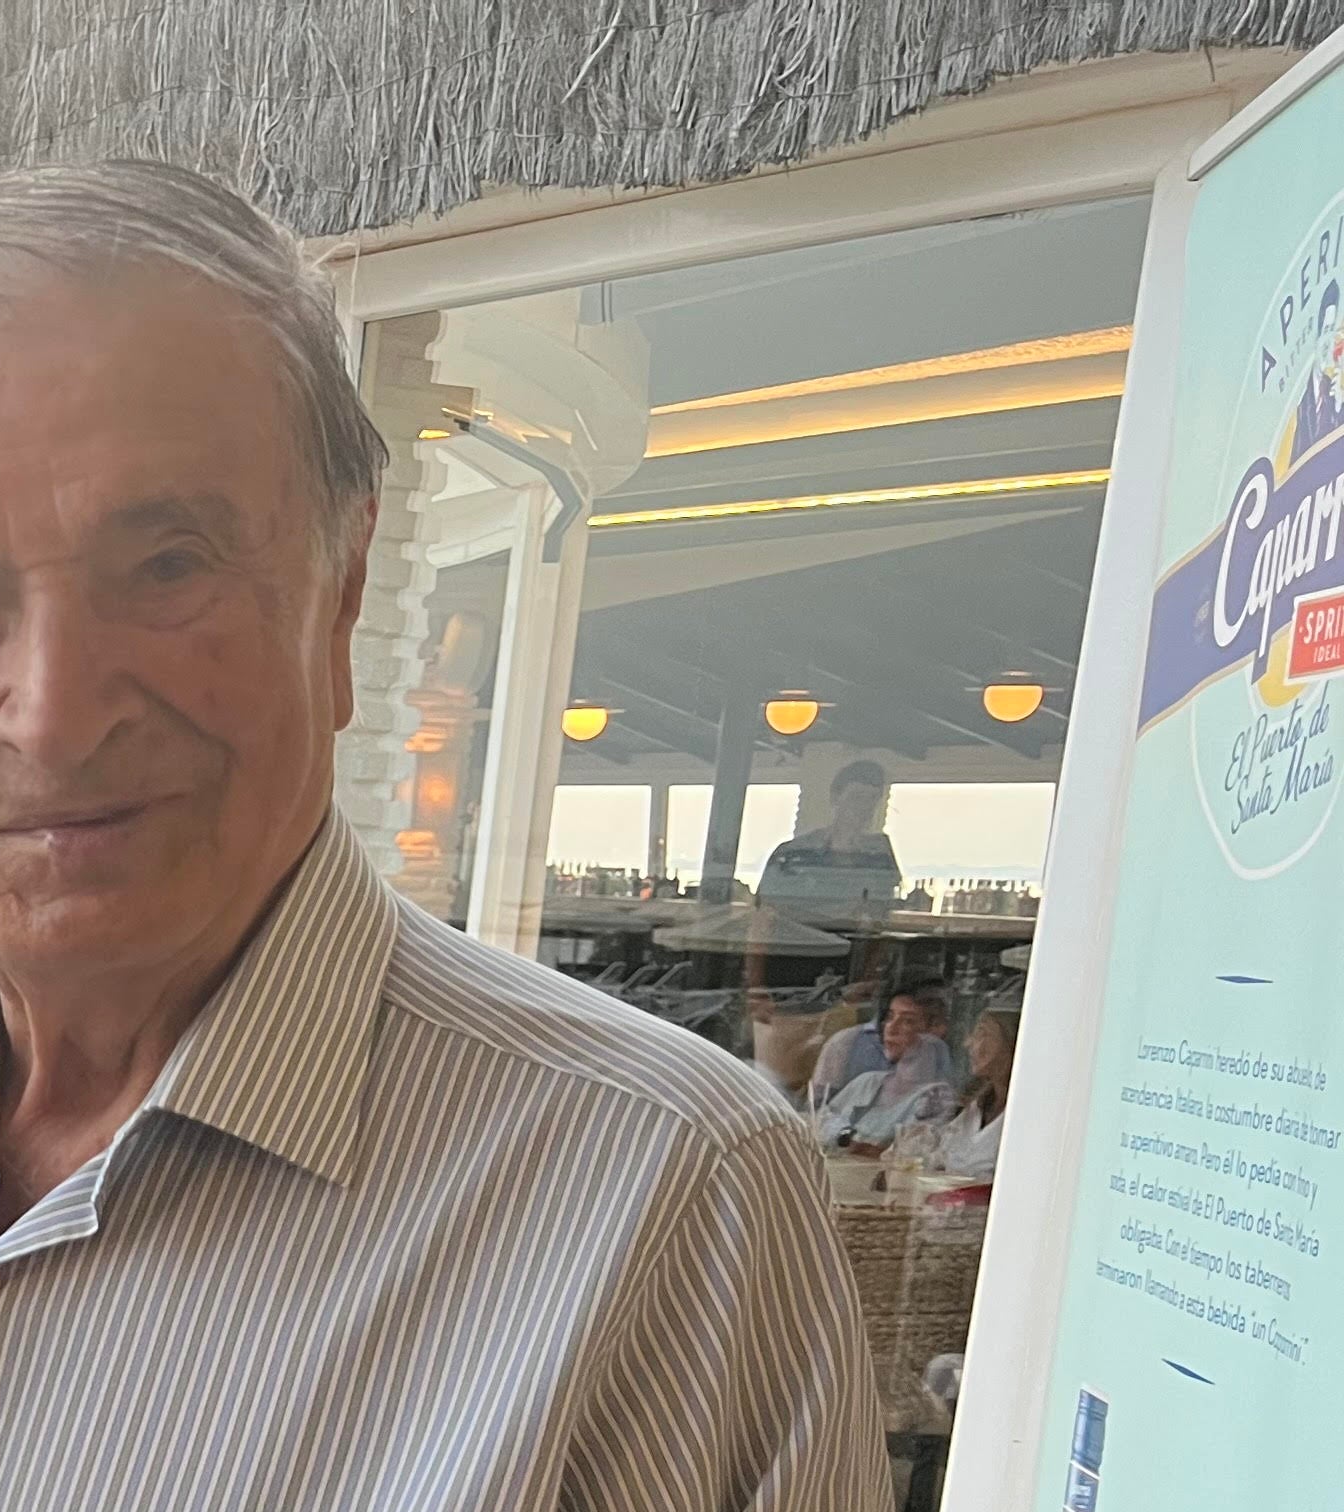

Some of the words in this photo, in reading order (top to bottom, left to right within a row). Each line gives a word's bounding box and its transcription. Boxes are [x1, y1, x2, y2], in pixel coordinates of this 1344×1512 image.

[1225, 726, 1252, 792] El
[1246, 697, 1304, 790] Puerto
[1309, 679, 1331, 739] de
[1231, 764, 1273, 835] Santa
[1269, 736, 1335, 816] María
[1137, 1036, 1176, 1064] Lorenzo
[1215, 1046, 1250, 1077] heredó
[1252, 1051, 1268, 1080] de
[1270, 1062, 1284, 1081] su
[1314, 1062, 1327, 1092] de
[1214, 1101, 1273, 1132] costumbre
[1309, 1119, 1342, 1150] tomar
[1130, 1131, 1174, 1159] aperitivo
[1201, 1142, 1221, 1172] Pero
[1223, 1149, 1234, 1175] él
[1236, 1151, 1246, 1178] lo
[1249, 1157, 1281, 1190] pedía
[1310, 1182, 1318, 1211] y
[1129, 1172, 1140, 1196] el
[1141, 1177, 1168, 1201] calor
[1191, 1190, 1203, 1217] de
[1204, 1193, 1215, 1219] El
[1215, 1196, 1254, 1232] Puerto
[1257, 1207, 1272, 1237] de
[1295, 1219, 1320, 1257] María
[1181, 1236, 1190, 1261] el
[1190, 1240, 1223, 1280] tiempo
[1226, 1250, 1242, 1280] los
[1186, 1295, 1205, 1319] esta
[1207, 1295, 1246, 1333] bebida
